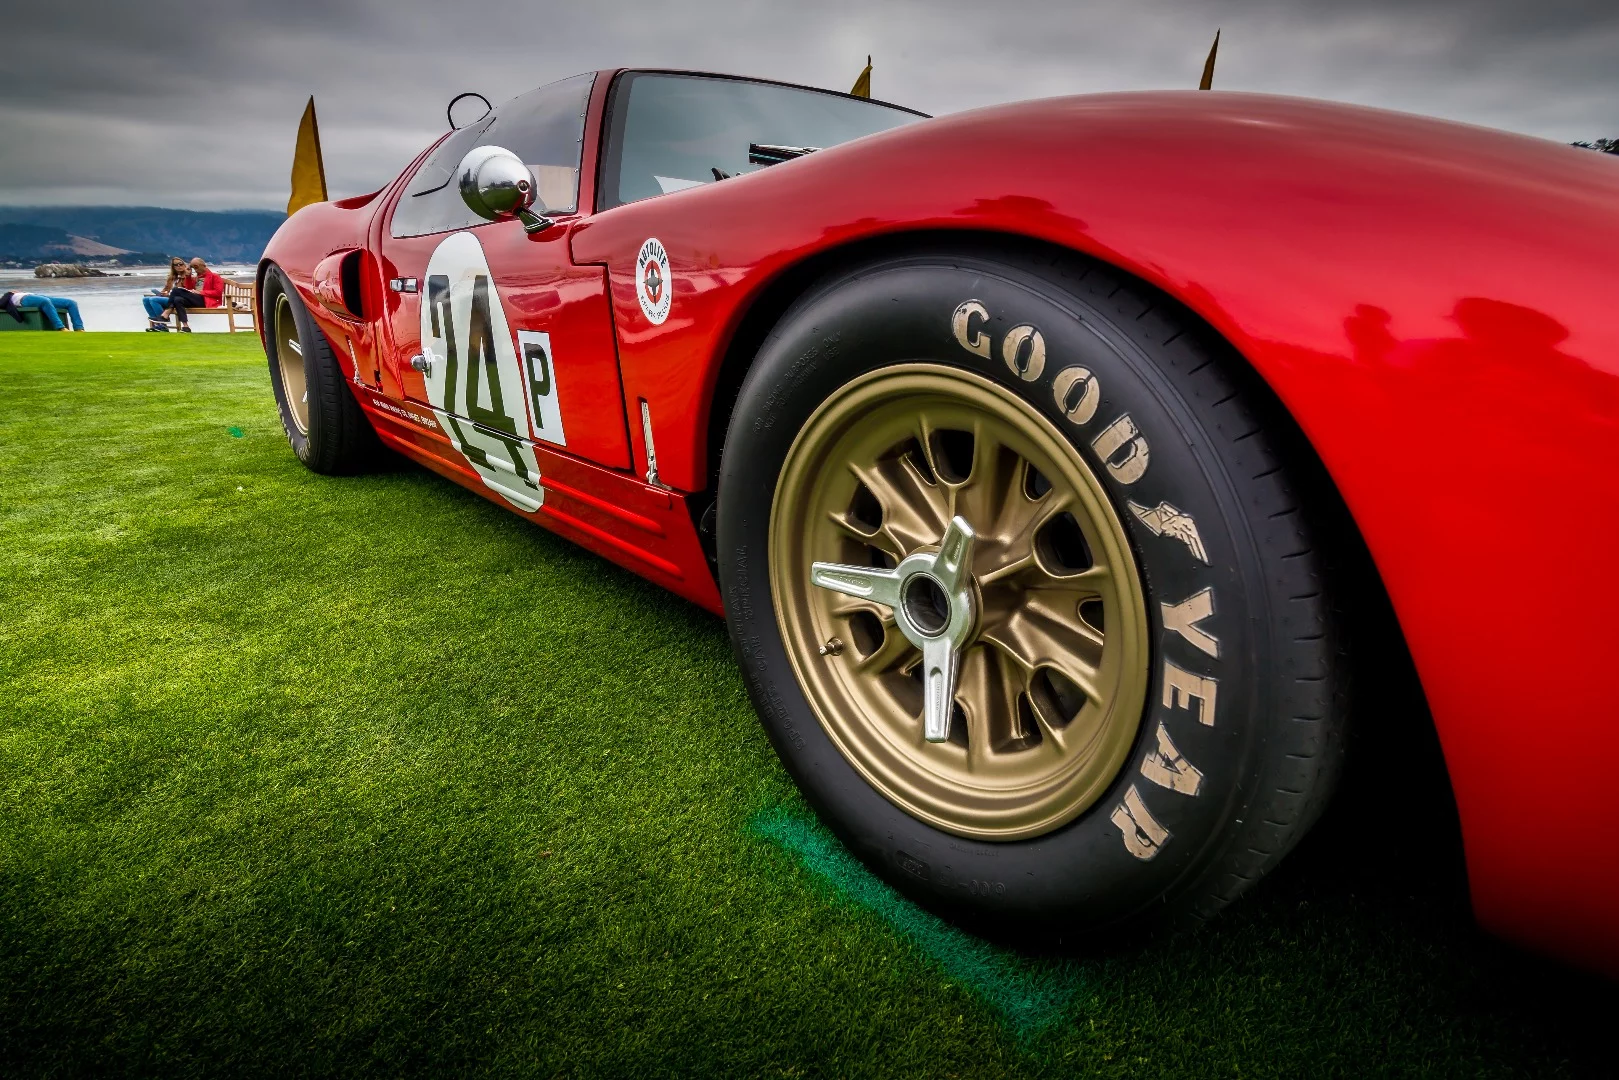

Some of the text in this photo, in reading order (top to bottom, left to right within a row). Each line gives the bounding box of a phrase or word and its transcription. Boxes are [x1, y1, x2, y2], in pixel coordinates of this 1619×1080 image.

[639, 241, 667, 269] AUTOLITE
[428, 274, 539, 491] 24
[524, 342, 551, 430] P
